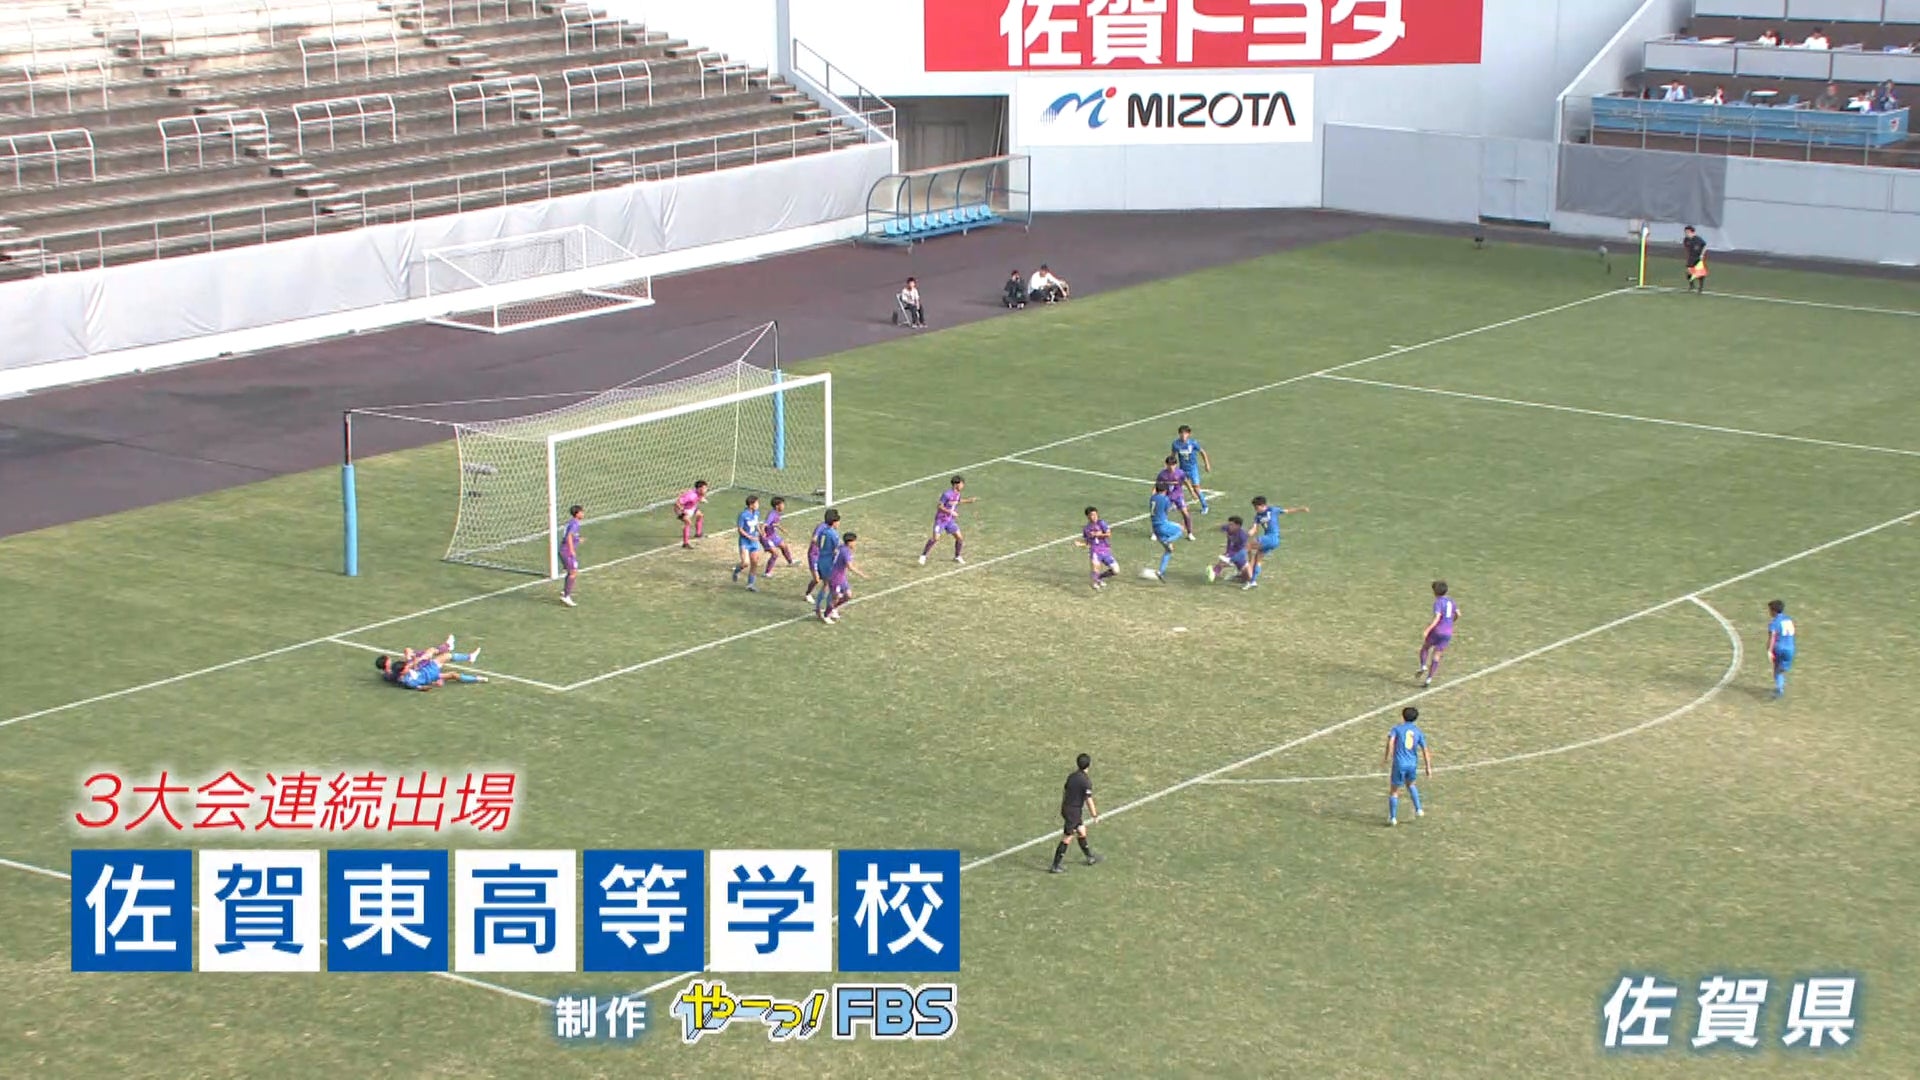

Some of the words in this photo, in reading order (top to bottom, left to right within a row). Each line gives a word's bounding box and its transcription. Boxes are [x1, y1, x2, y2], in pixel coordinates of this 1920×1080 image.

[999, 0, 1406, 66] 佐賀トヨタ
[1127, 91, 1296, 128] MIZOTA
[1405, 729, 1414, 750] 6
